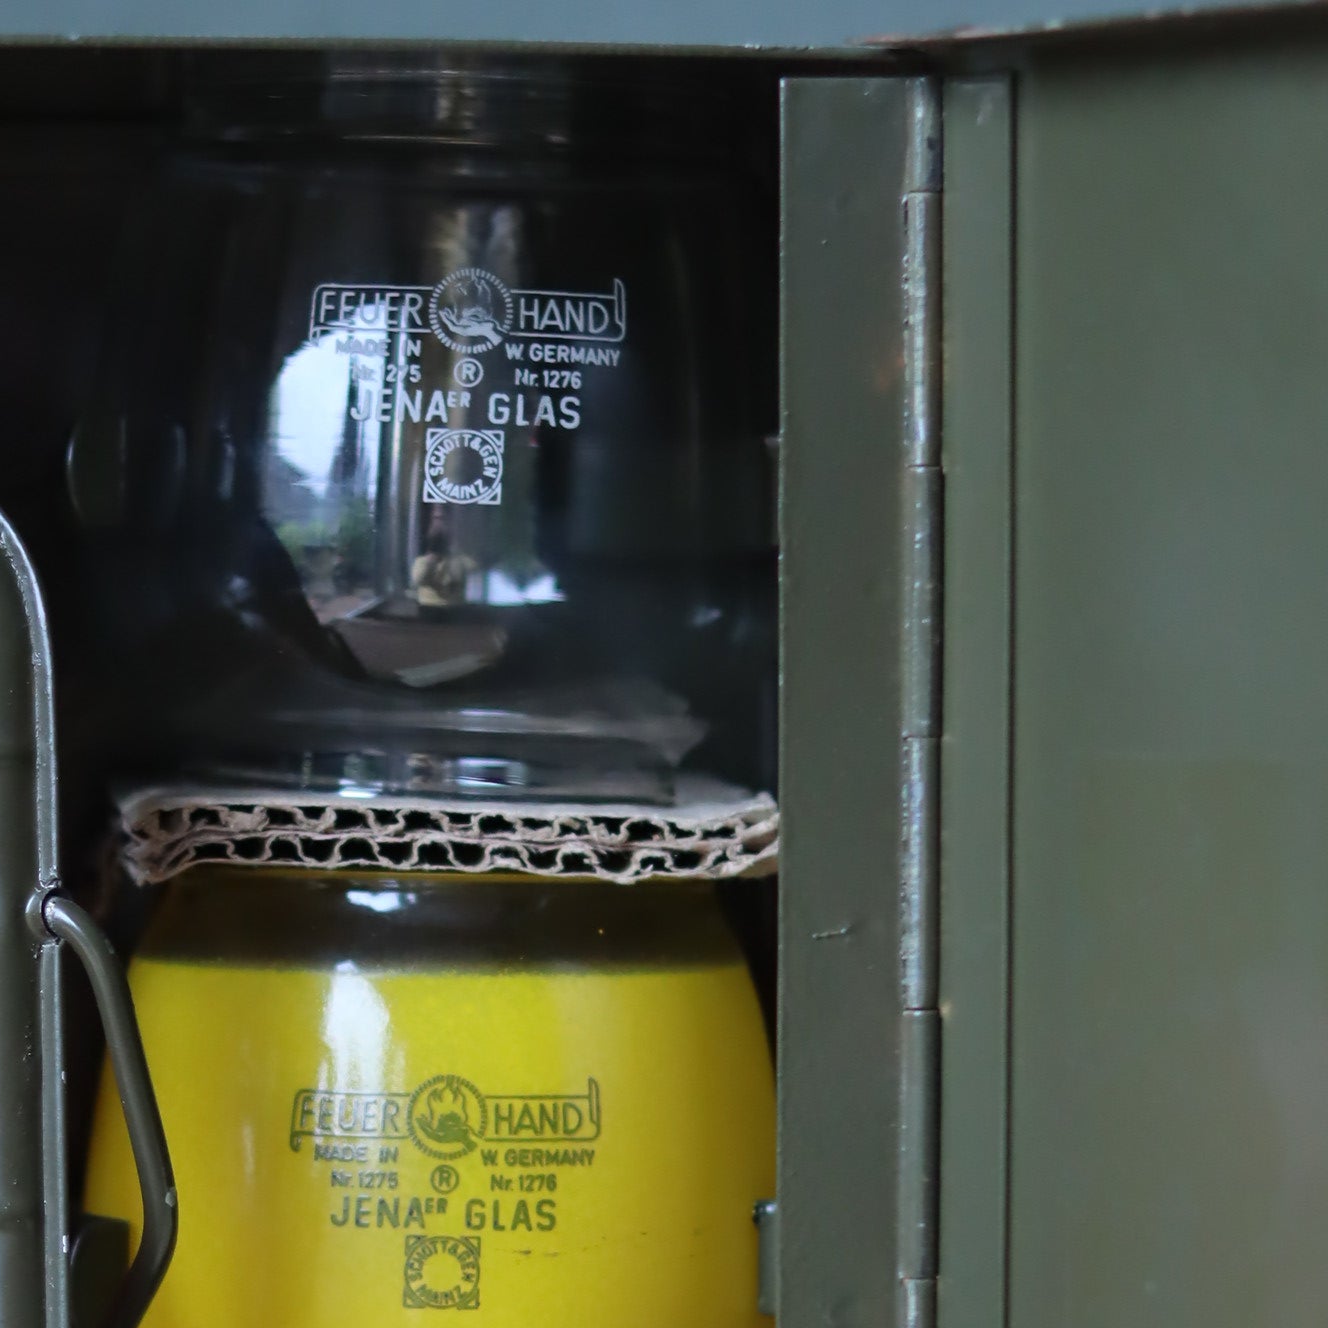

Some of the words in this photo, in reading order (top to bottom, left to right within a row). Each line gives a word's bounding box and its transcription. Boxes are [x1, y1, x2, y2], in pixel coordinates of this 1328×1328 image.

[319, 291, 423, 326] FEUER
[520, 298, 609, 334] HAND
[334, 338, 392, 356] MADE
[529, 344, 620, 366] GERMANY
[515, 369, 539, 388] Nr.
[543, 370, 581, 389] 1276
[489, 393, 580, 429] GLAS
[300, 1096, 399, 1134] FEUER
[495, 1103, 583, 1136] HAND
[314, 1144, 367, 1163] MADE
[379, 1147, 398, 1163] IN
[505, 1149, 594, 1166] GERMANY
[490, 1174, 513, 1191] Nr.
[519, 1174, 556, 1191] 1276
[465, 1199, 556, 1232] GLAS
